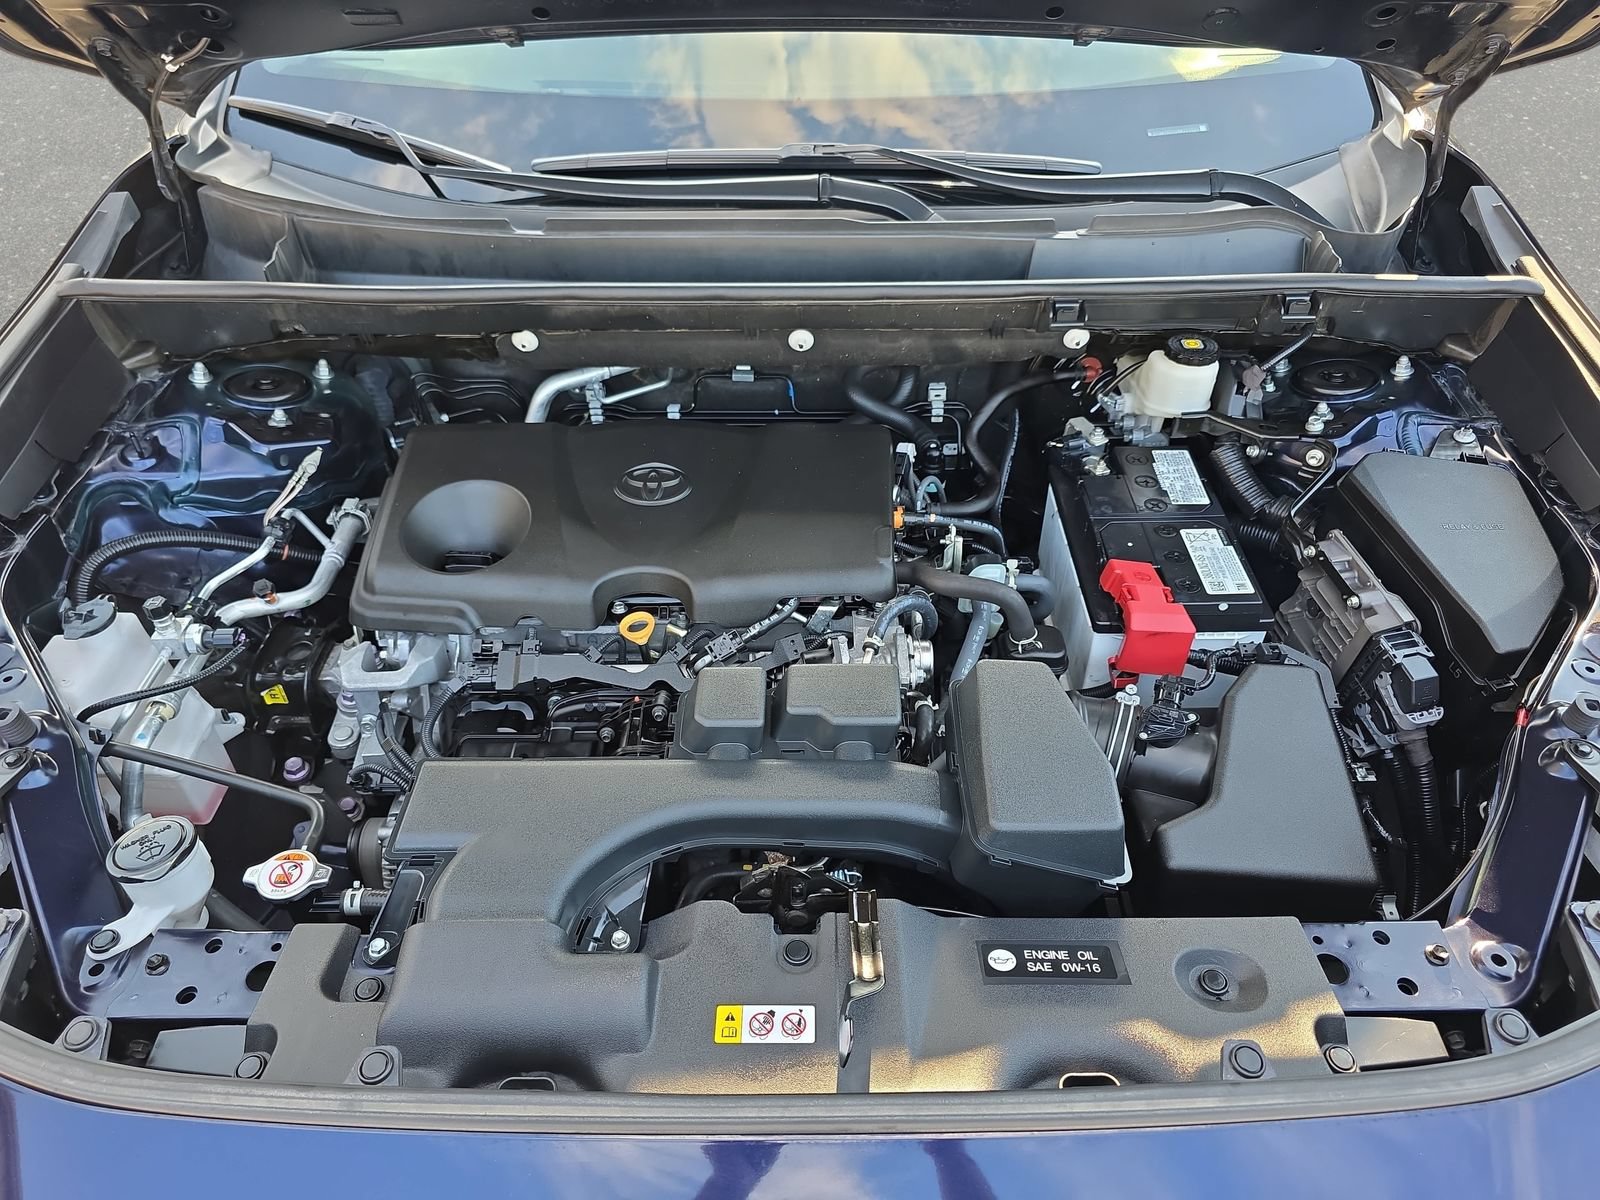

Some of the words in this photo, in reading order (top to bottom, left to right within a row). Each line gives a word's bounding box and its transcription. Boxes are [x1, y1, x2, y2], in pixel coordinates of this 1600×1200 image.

[1023, 950, 1070, 960] ENGINE
[1077, 951, 1099, 961] OIL
[1027, 962, 1053, 972] SAE
[1062, 963, 1101, 973] 0W-16
